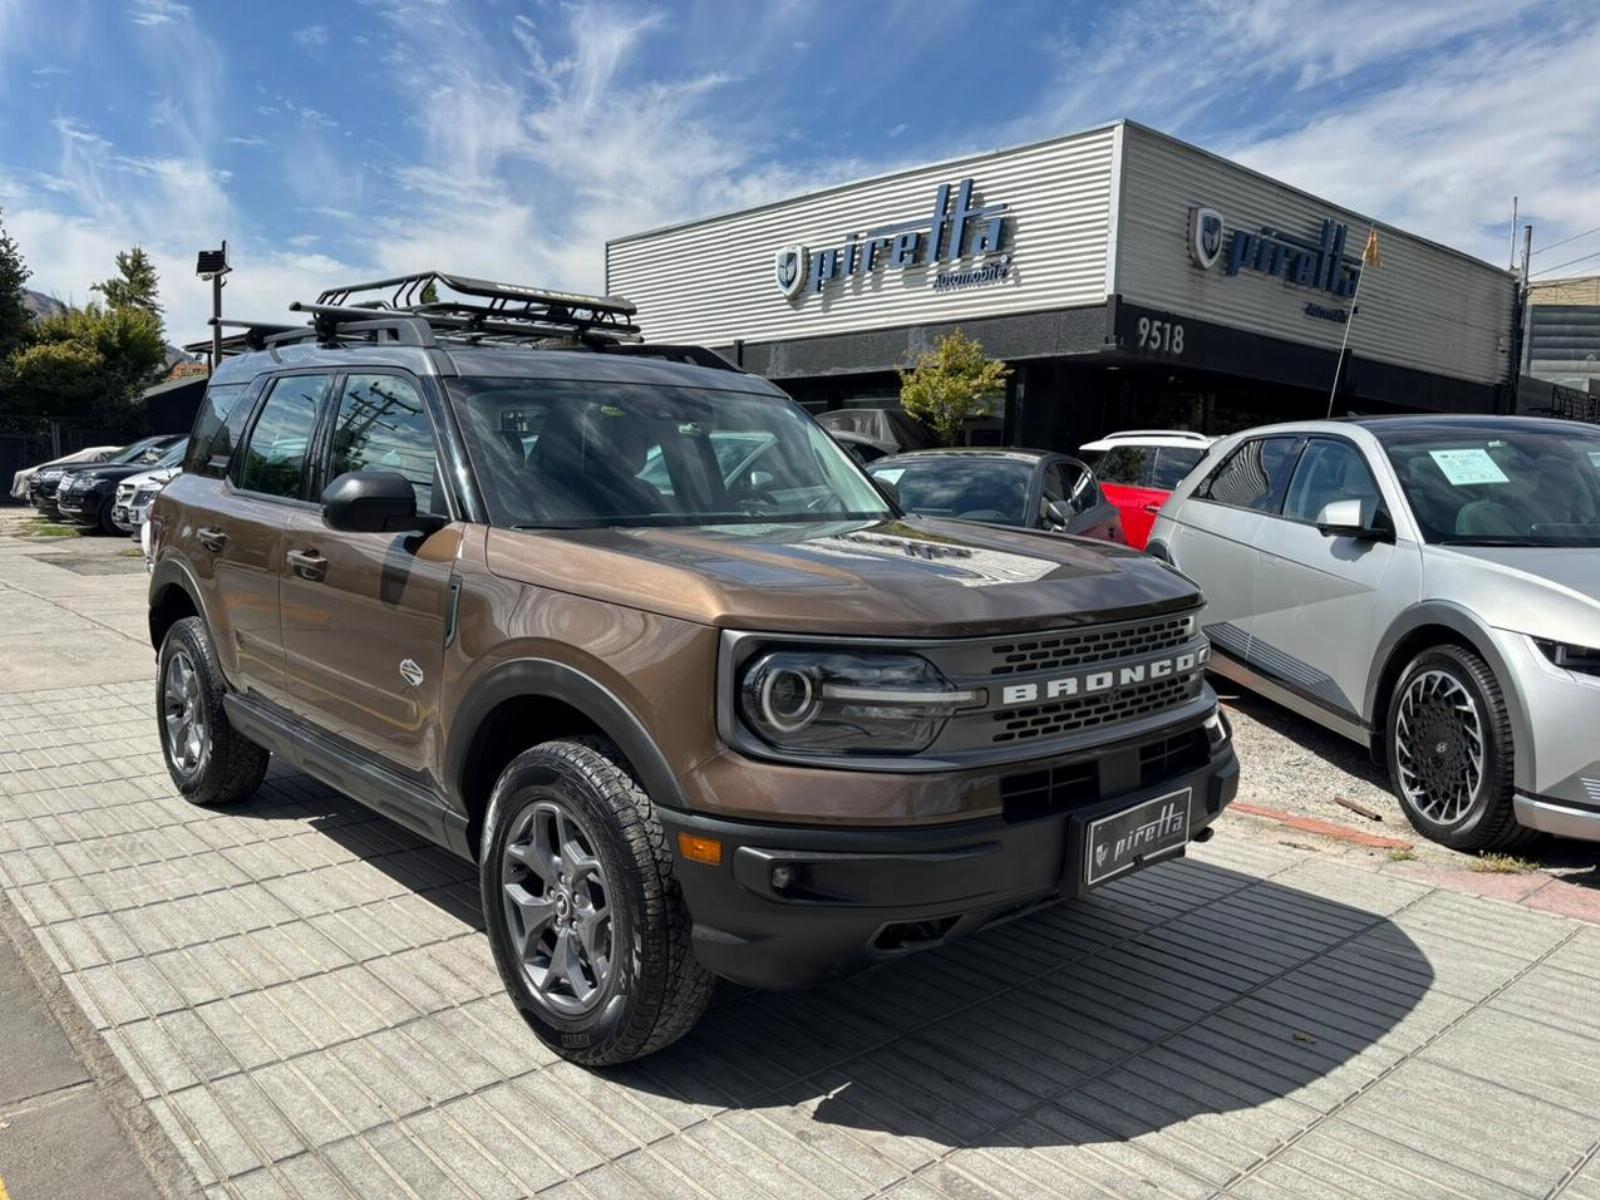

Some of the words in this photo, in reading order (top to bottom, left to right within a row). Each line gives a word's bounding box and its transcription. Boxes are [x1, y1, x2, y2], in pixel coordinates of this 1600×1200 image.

[809, 178, 1008, 292] piretta
[1225, 217, 1362, 297] piretta
[1139, 316, 1184, 354] 9518
[1003, 653, 1195, 704] BRONCO
[1114, 803, 1184, 861] piretta
